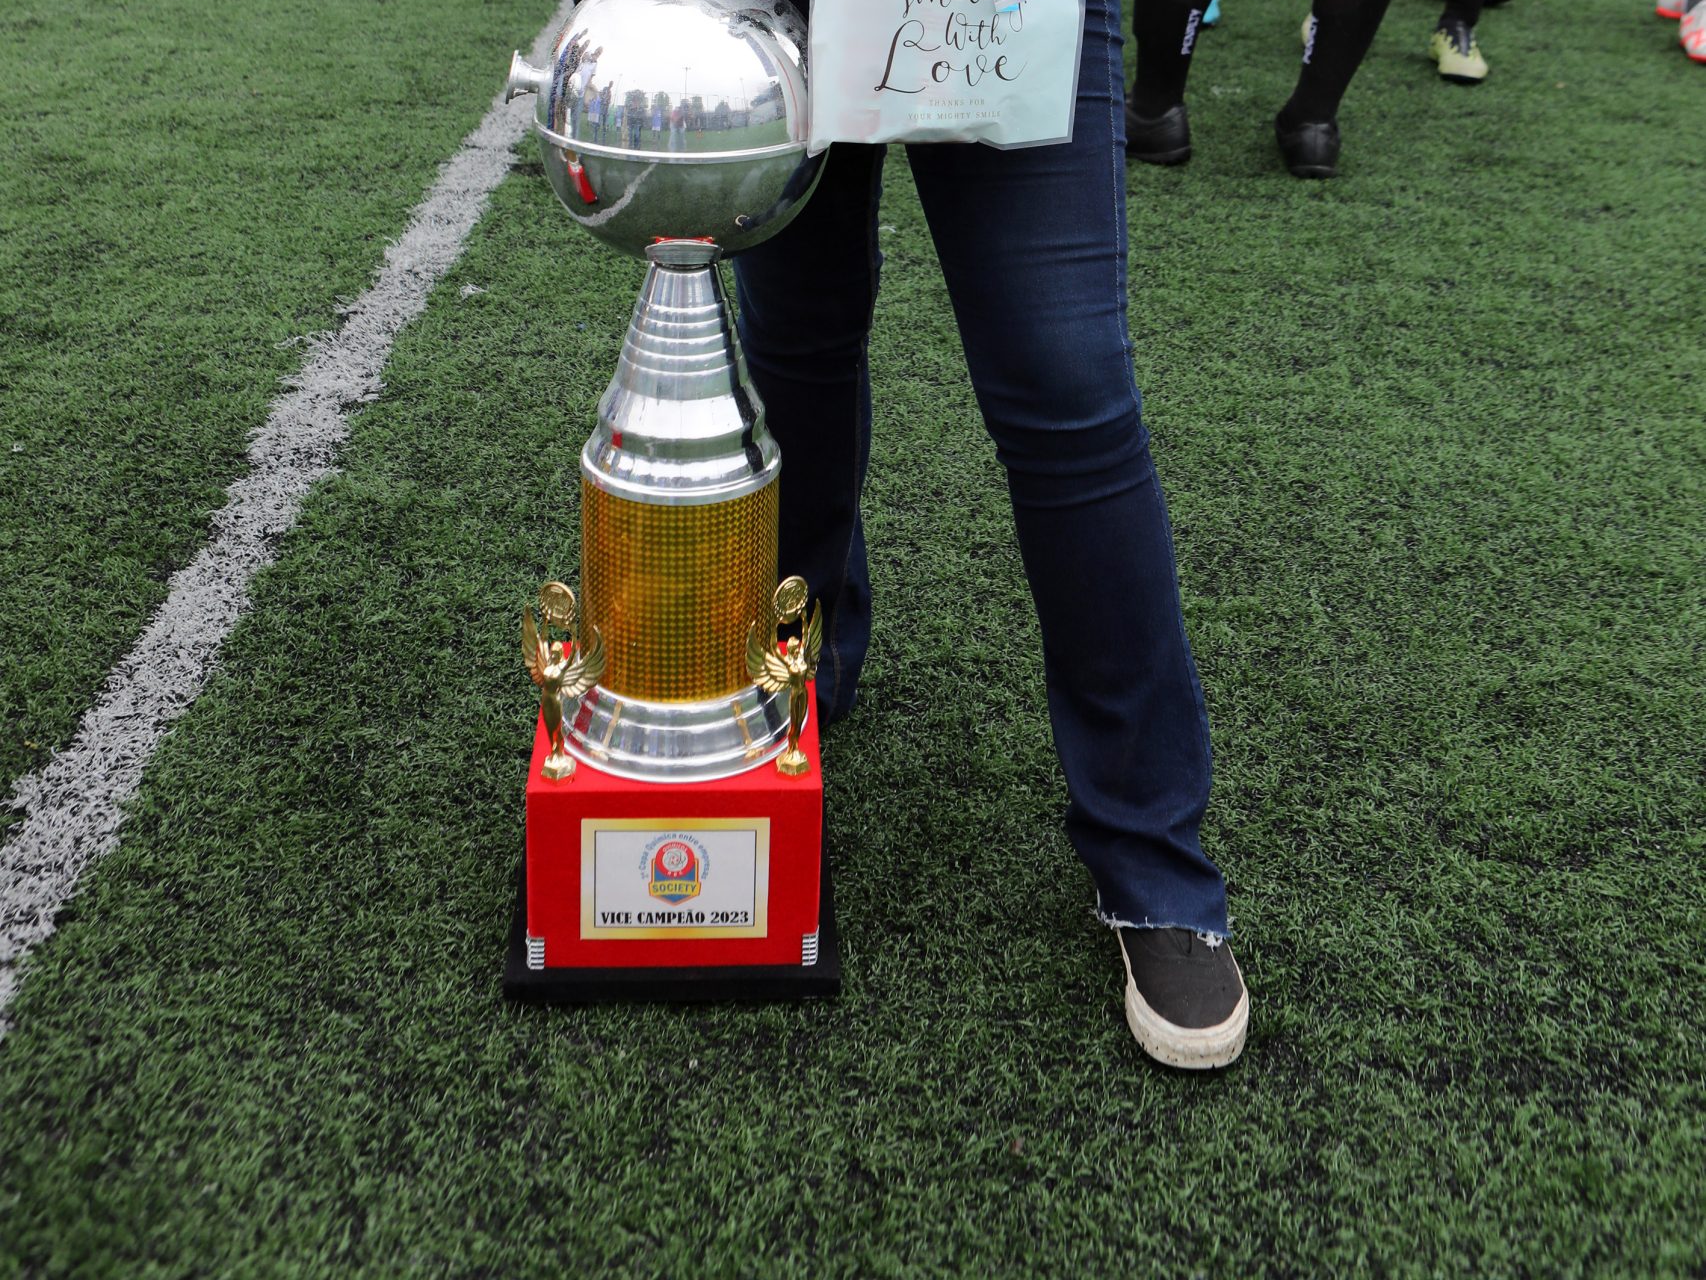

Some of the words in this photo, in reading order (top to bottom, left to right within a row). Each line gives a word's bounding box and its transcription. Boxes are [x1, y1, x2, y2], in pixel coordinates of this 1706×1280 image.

[945, 12, 1007, 51] With
[874, 20, 1029, 94] Love
[929, 98, 965, 107] THANKS
[969, 98, 985, 106] FOR
[907, 112, 932, 121] YOUR
[936, 111, 971, 120] MIGHTY
[975, 110, 1001, 119] SMILE
[678, 833, 699, 846] entre
[652, 882, 697, 894] SOCIETY
[600, 911, 632, 925] VICE
[637, 909, 706, 925] CAMPEÃO
[709, 910, 749, 925] 2023
